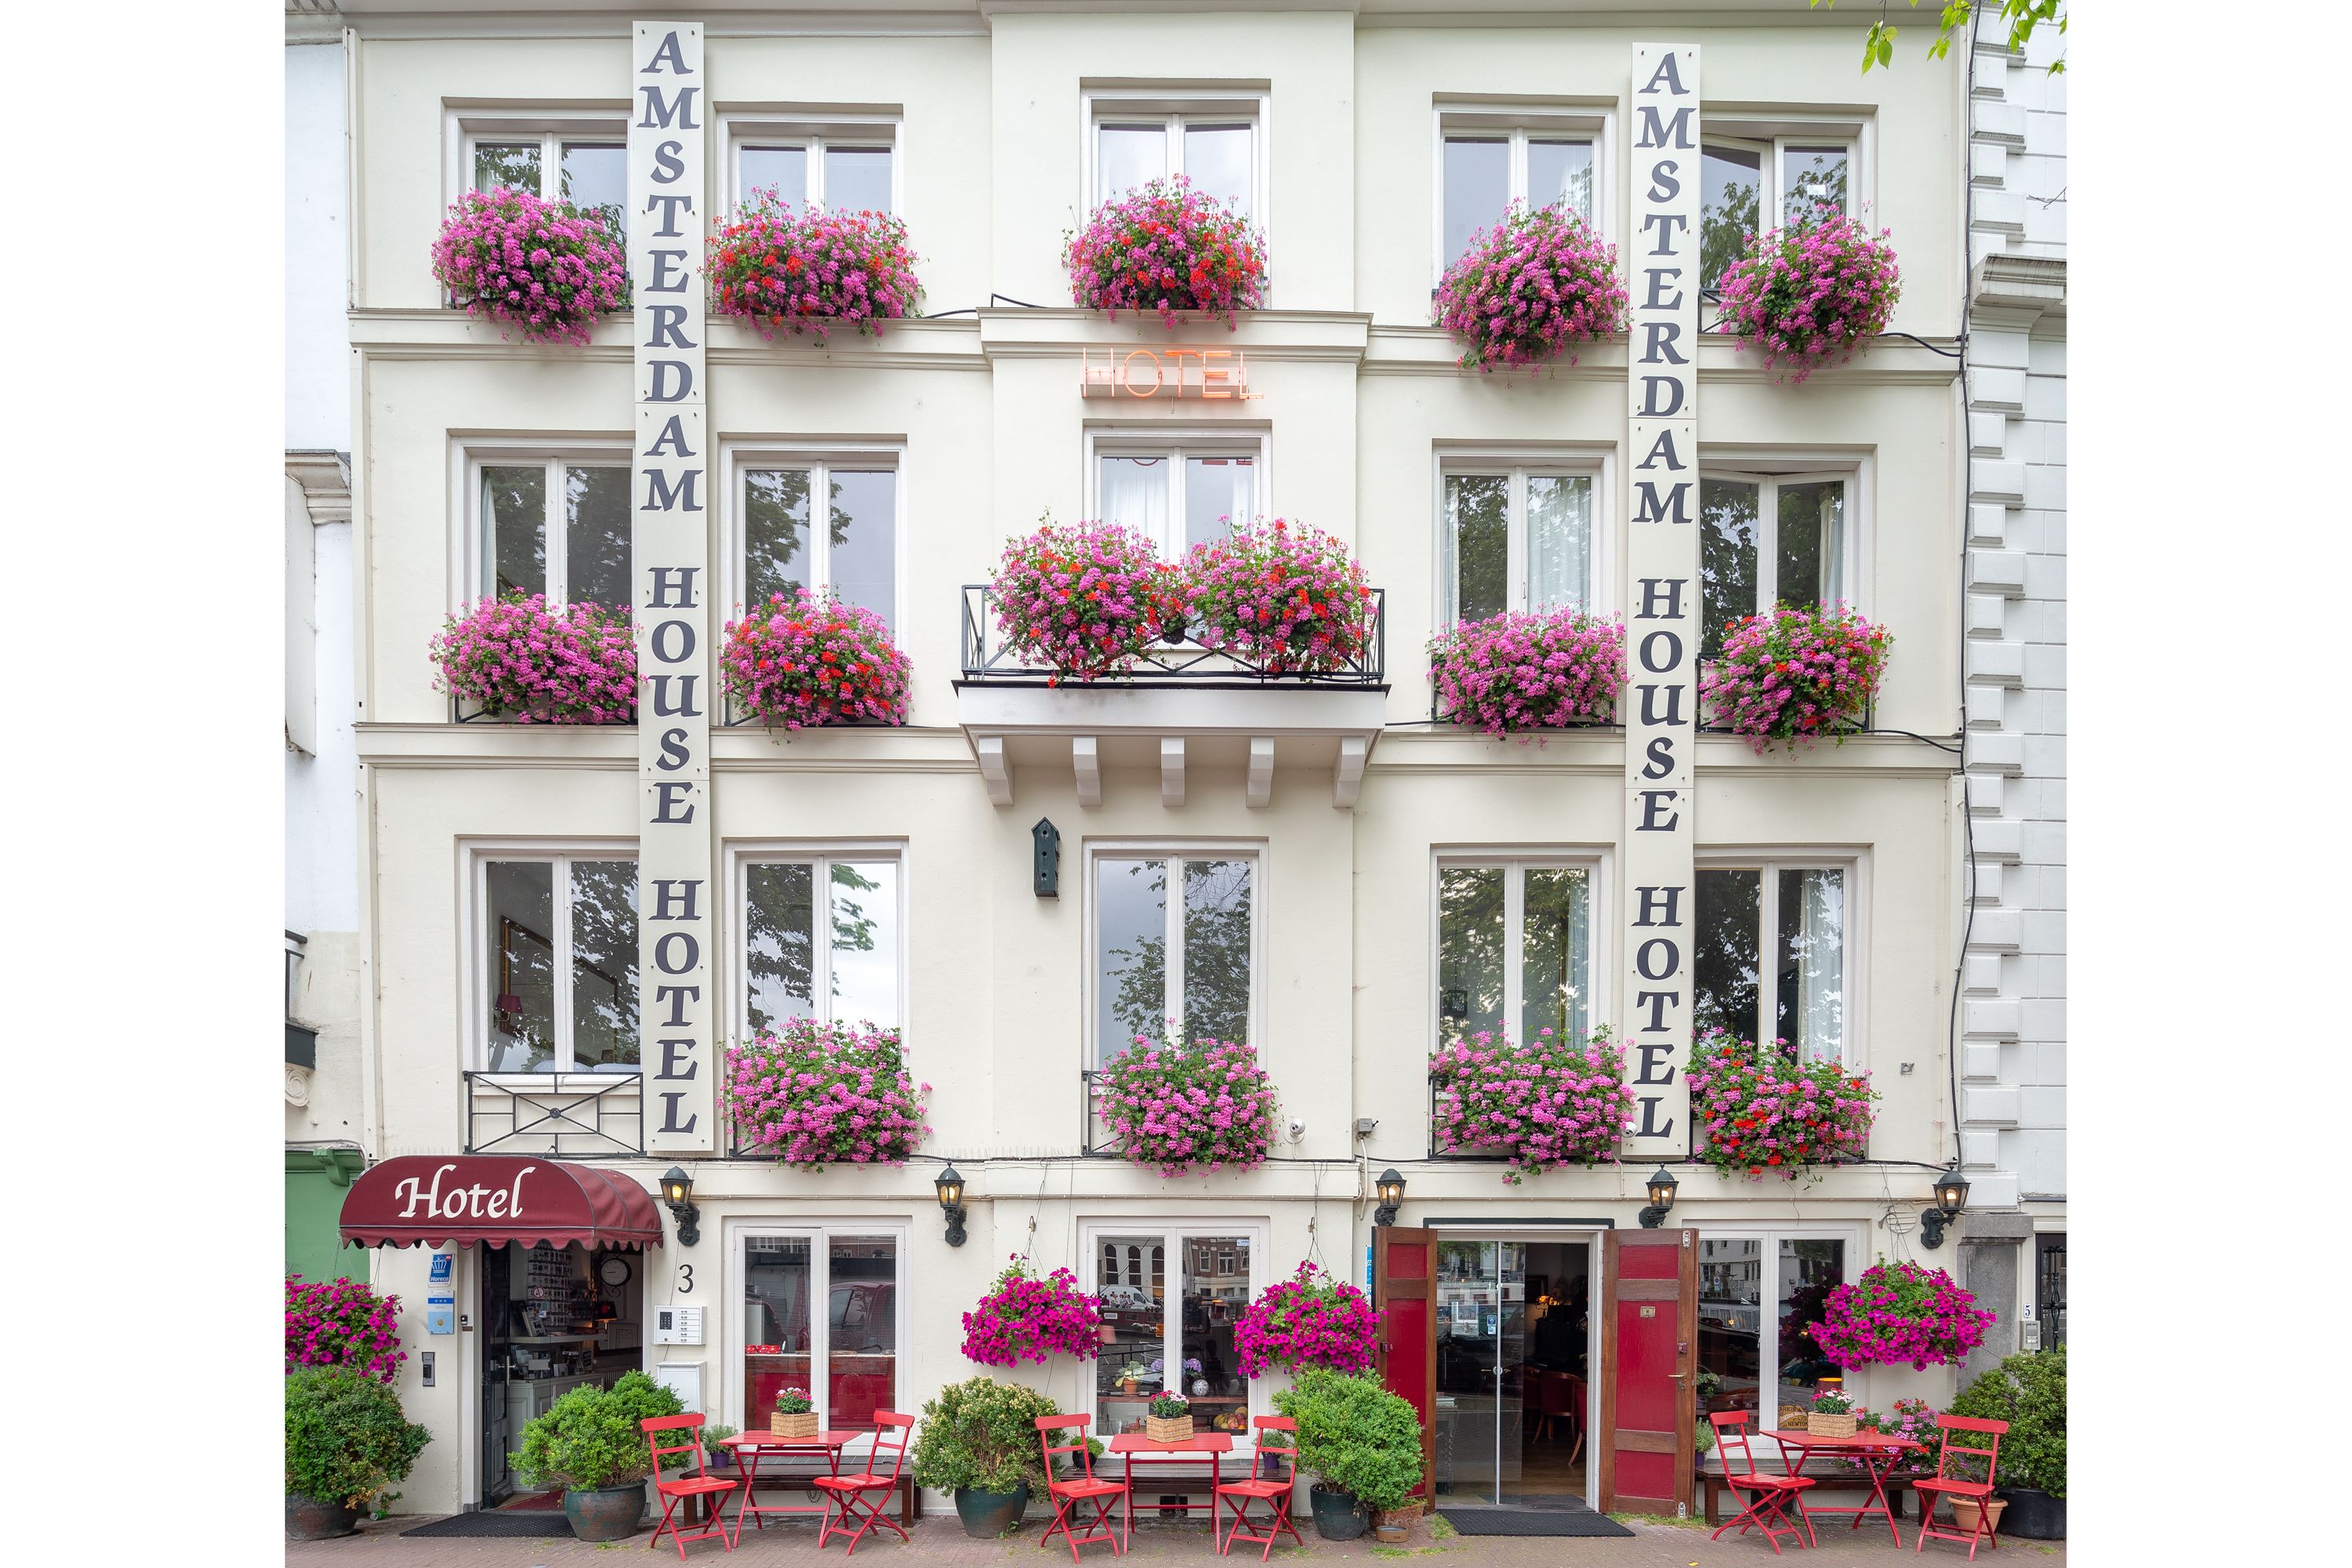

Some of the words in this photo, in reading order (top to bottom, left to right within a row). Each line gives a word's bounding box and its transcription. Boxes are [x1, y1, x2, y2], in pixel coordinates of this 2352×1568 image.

[637, 31, 704, 512] AMSTERDAM
[1083, 347, 1264, 400] HOTEL
[1631, 52, 1697, 524] AMSTERDAM
[645, 567, 703, 825] HOUSE
[1633, 578, 1690, 832] HOUSE
[648, 880, 705, 1134] HOTEL
[1631, 886, 1687, 1138] HOTEL
[395, 1163, 536, 1218] Hotel
[678, 1264, 694, 1294] 3
[2025, 1305, 2031, 1317] 5
